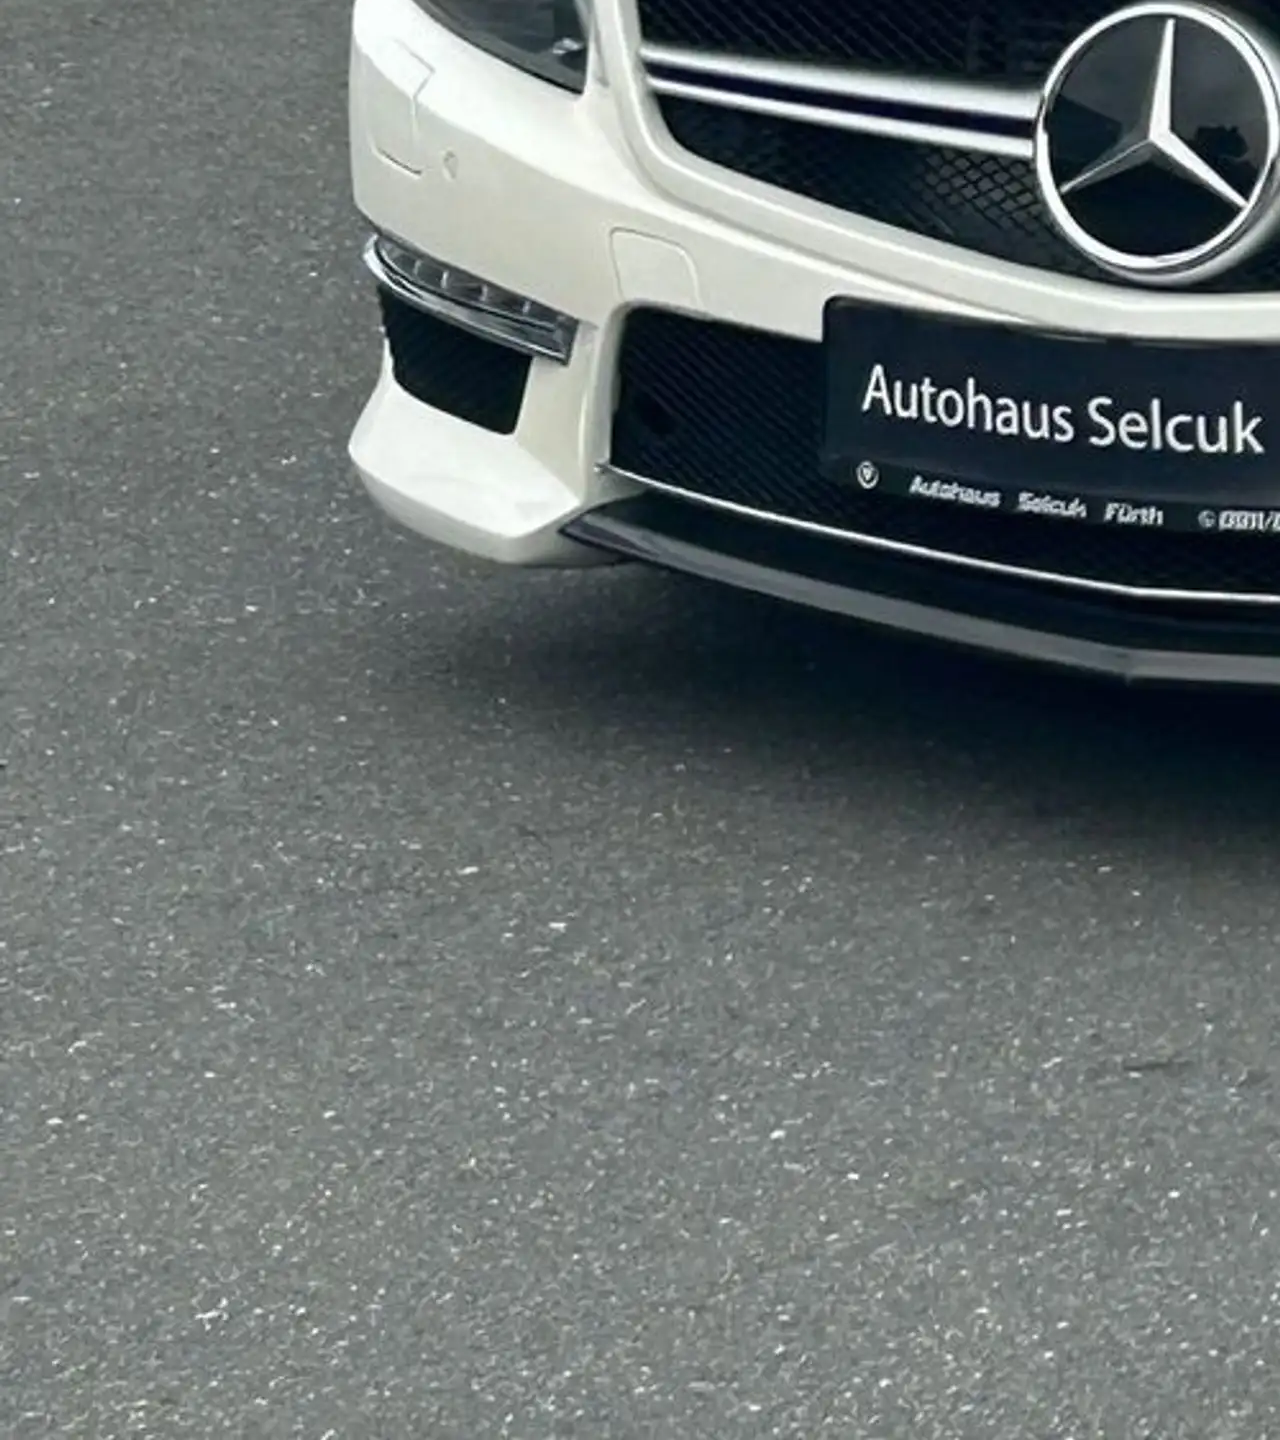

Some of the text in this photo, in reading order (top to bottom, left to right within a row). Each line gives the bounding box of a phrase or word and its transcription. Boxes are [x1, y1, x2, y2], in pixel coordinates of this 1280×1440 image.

[862, 363, 1265, 455] Autohaus Selcuk
[909, 475, 1001, 508] Autohaus
[1018, 491, 1088, 519] Selcuk
[1103, 502, 1165, 527] Fürth
